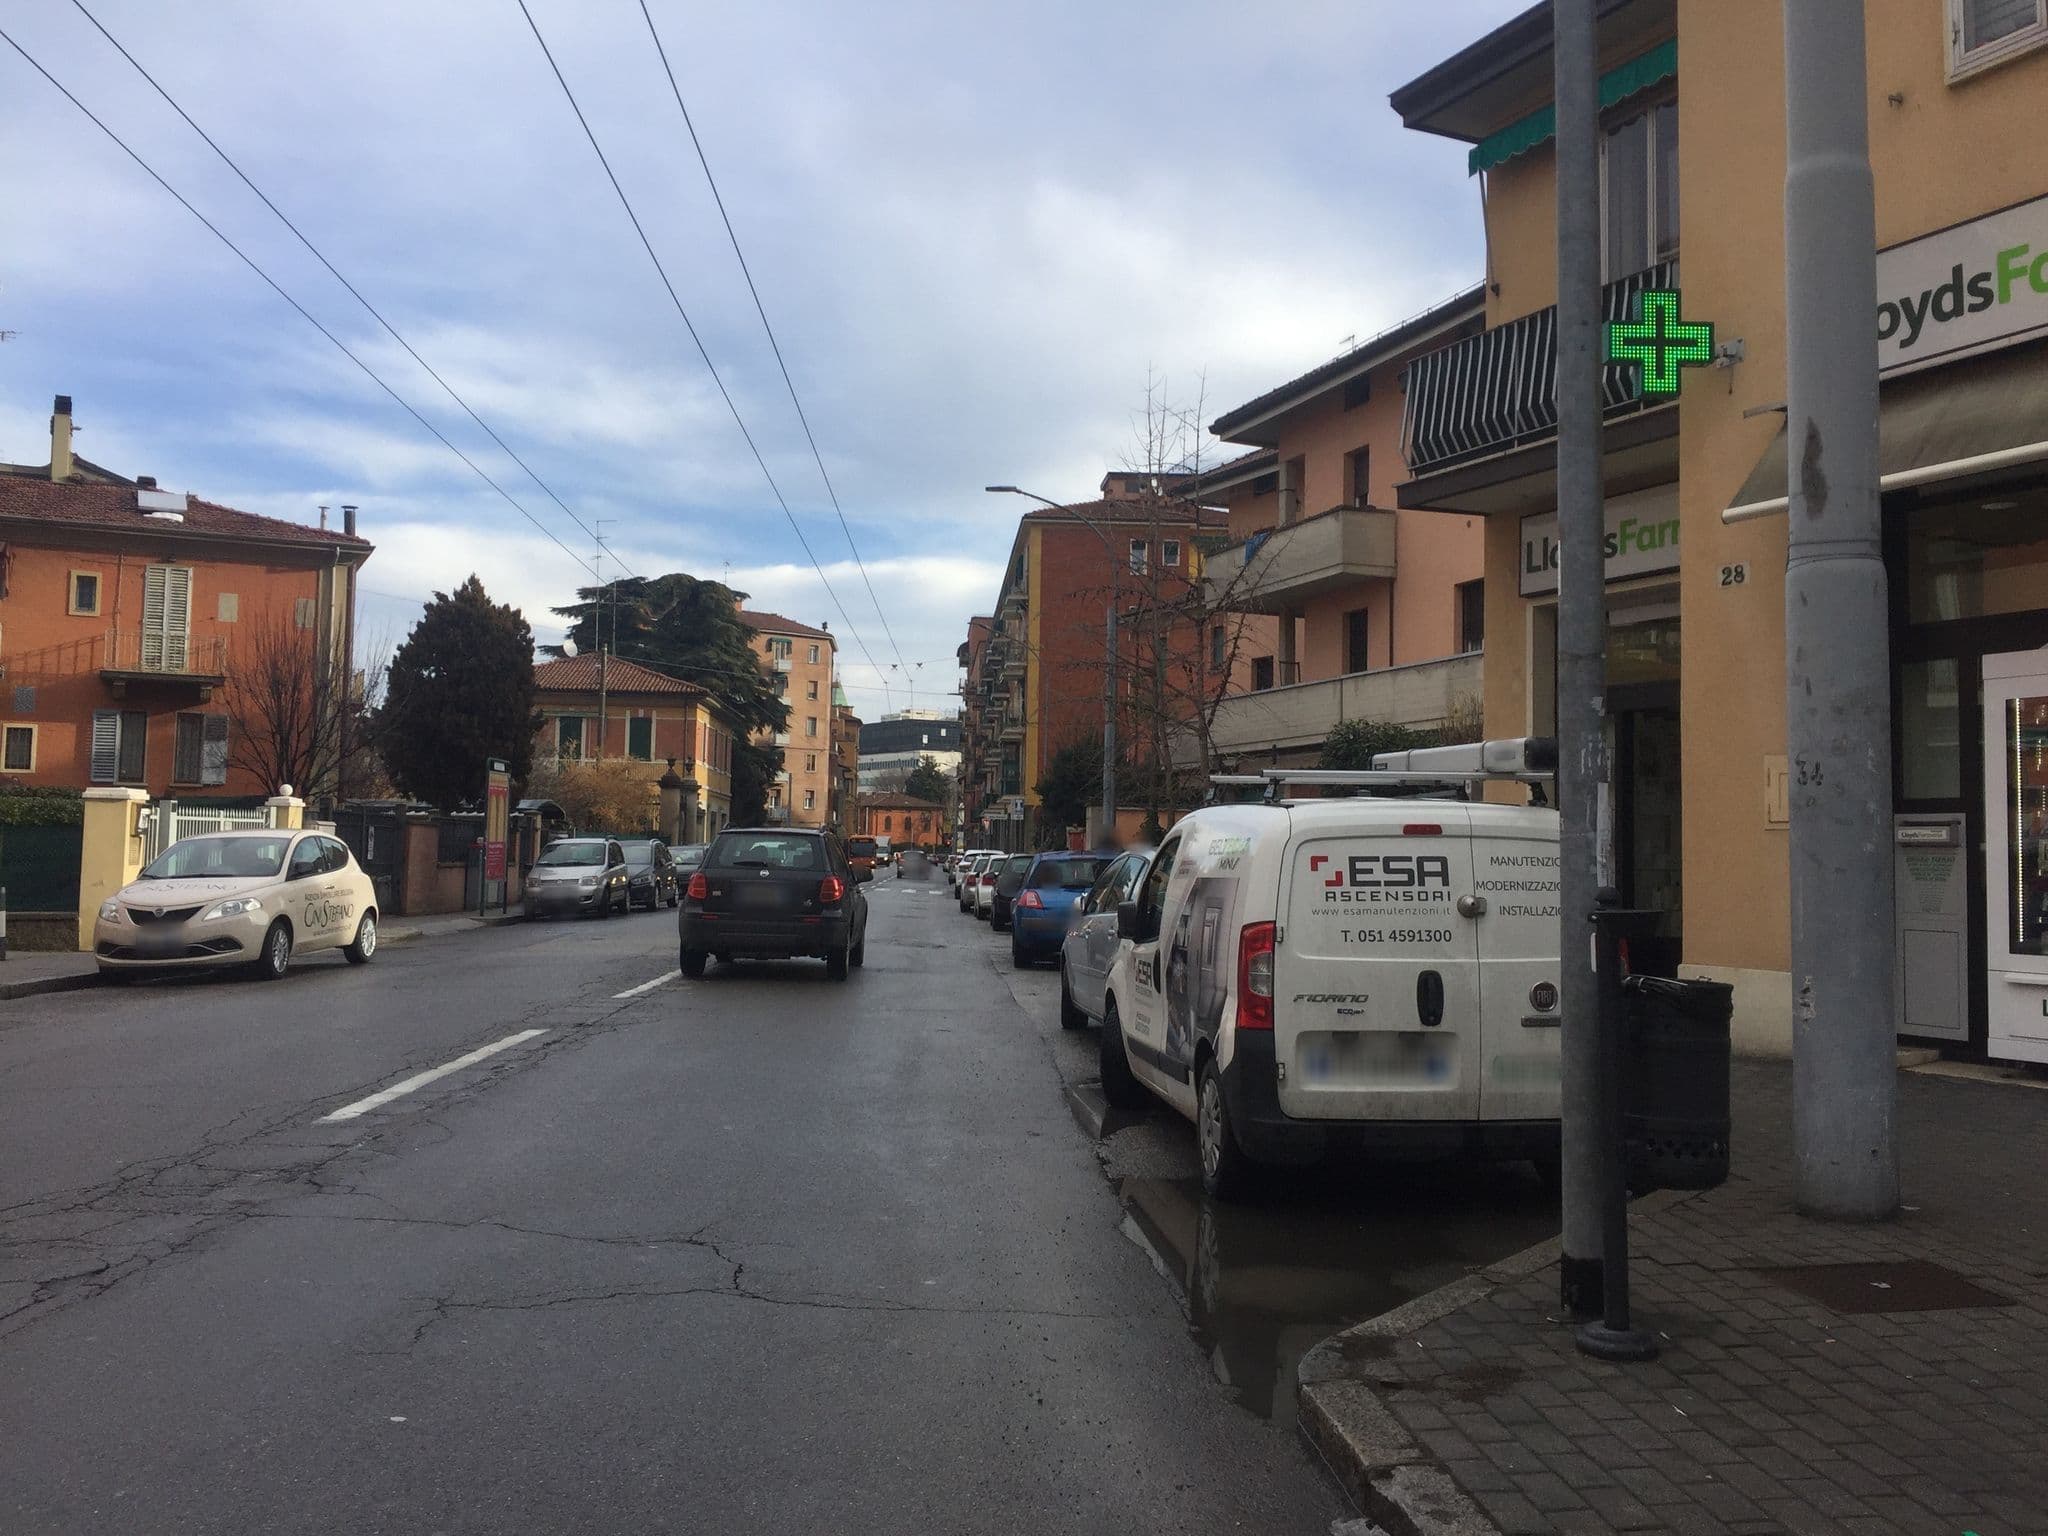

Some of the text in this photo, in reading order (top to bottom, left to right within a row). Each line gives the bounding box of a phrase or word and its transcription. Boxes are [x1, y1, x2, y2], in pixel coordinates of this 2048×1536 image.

[1721, 564, 1745, 586] 28
[1348, 856, 1450, 887] ESA
[1324, 891, 1451, 902] ASCENSORI
[1311, 906, 1451, 917] www.esamanutenzioni.it
[1341, 929, 1452, 943] T. 051 4591300
[1293, 994, 1369, 1003] FIORINO
